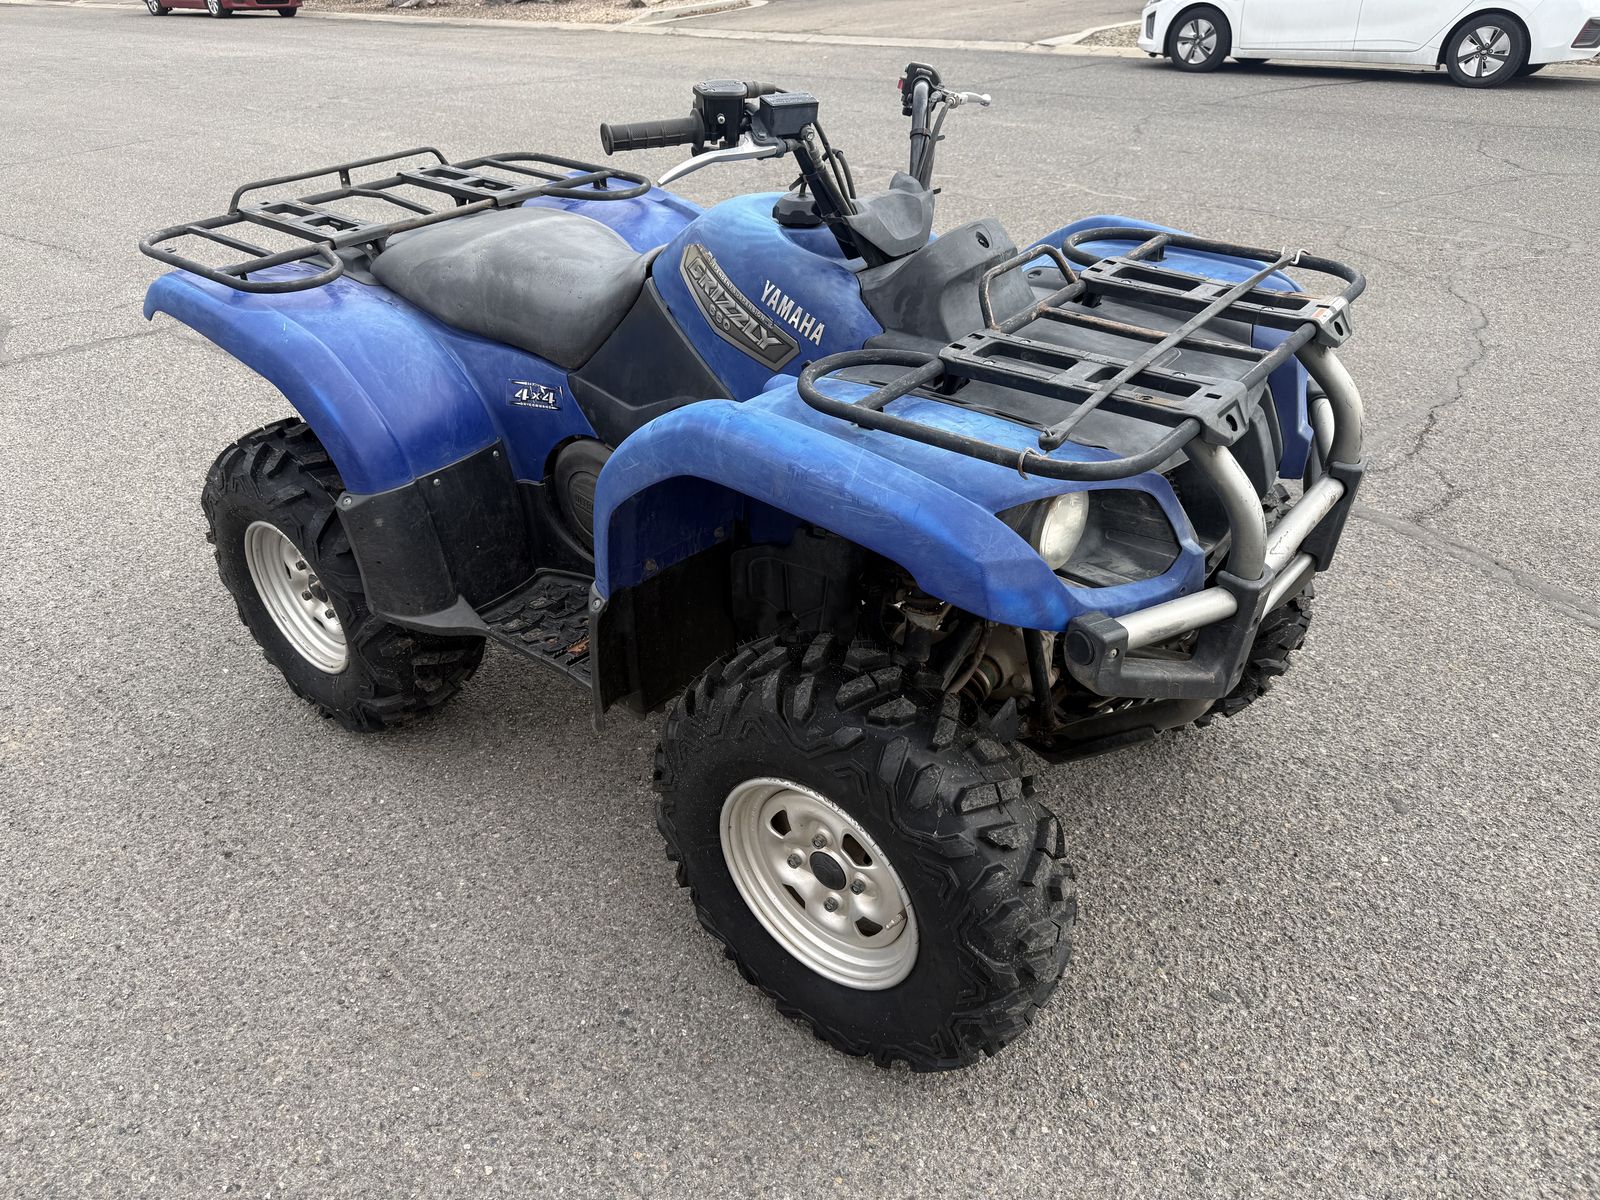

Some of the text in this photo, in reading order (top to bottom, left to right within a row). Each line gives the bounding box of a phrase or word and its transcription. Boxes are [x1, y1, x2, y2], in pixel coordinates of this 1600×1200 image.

[687, 256, 784, 351] GRIZZLY
[708, 304, 731, 331] 660
[760, 279, 825, 346] YAMAHA
